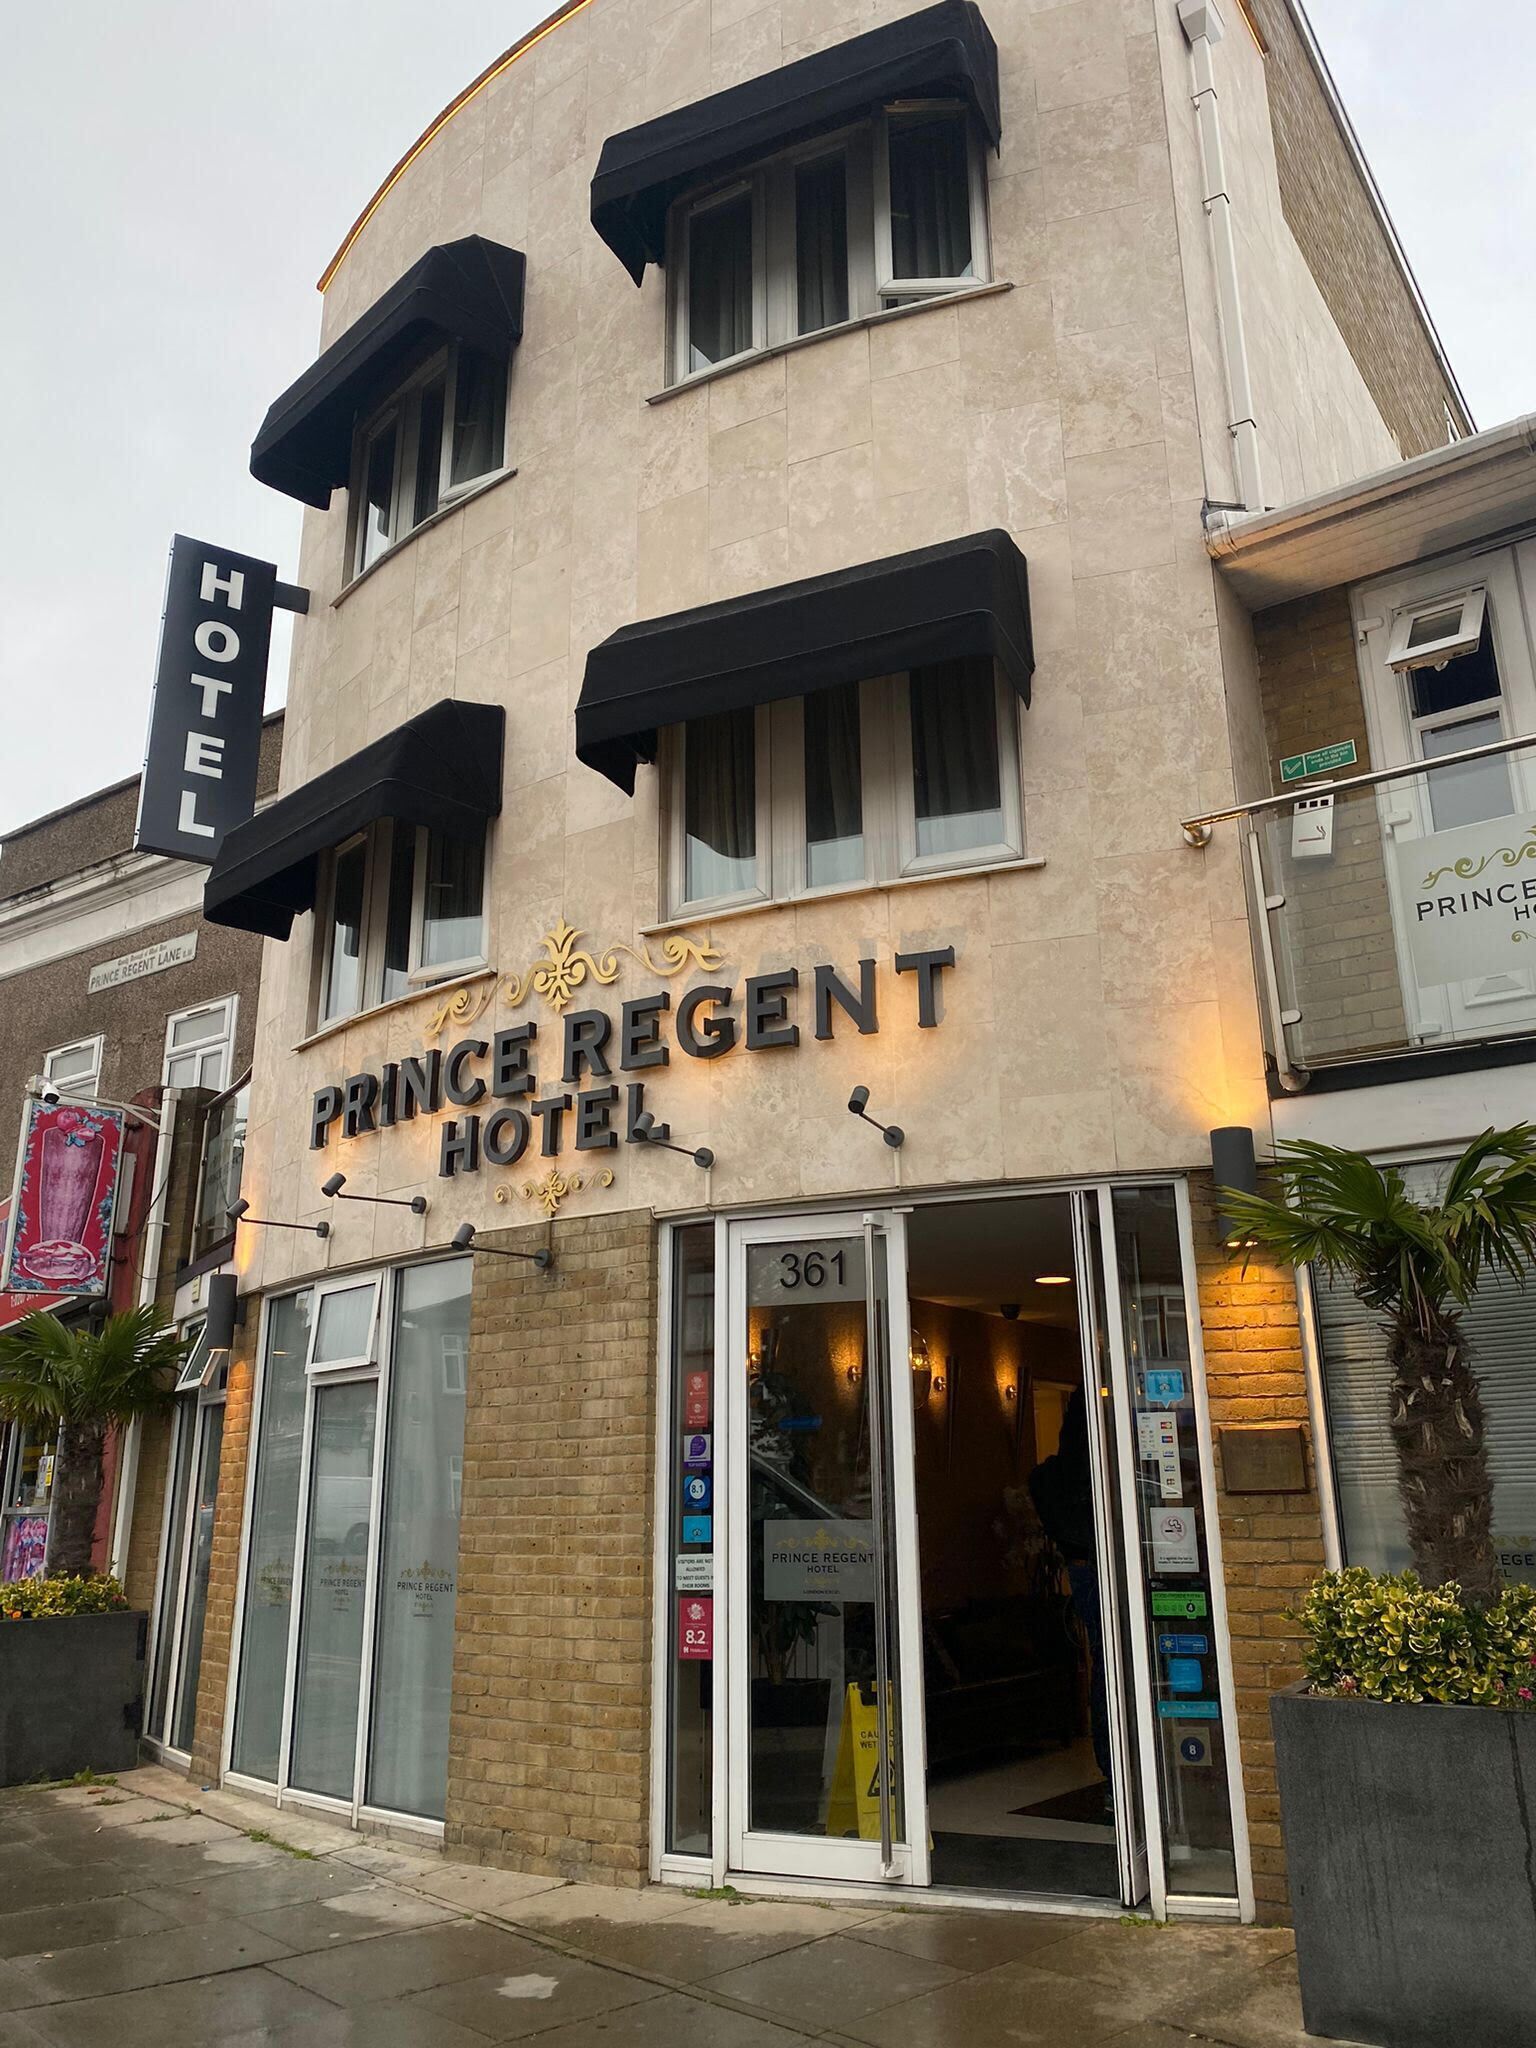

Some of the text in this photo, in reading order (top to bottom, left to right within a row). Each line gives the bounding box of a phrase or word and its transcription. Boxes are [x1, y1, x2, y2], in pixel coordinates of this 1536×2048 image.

[177, 561, 245, 839] HOTEL
[1416, 879, 1536, 921] PRINCE
[90, 968, 120, 989] PRINCE
[122, 957, 156, 980] REGENT
[157, 947, 182, 966] LANE
[309, 944, 956, 1150] PRINCE REGENT
[438, 1083, 671, 1178] HOTEL
[780, 1250, 843, 1288] 361
[691, 1484, 703, 1494] 8.1
[772, 1553, 874, 1563] PRINCE REGENT
[807, 1565, 840, 1573] HOTEL
[397, 1581, 454, 1593] PRINCE REGENT
[415, 1593, 433, 1601] HOTEL
[685, 1629, 706, 1644] 8.2
[860, 1741, 877, 1749] WET
